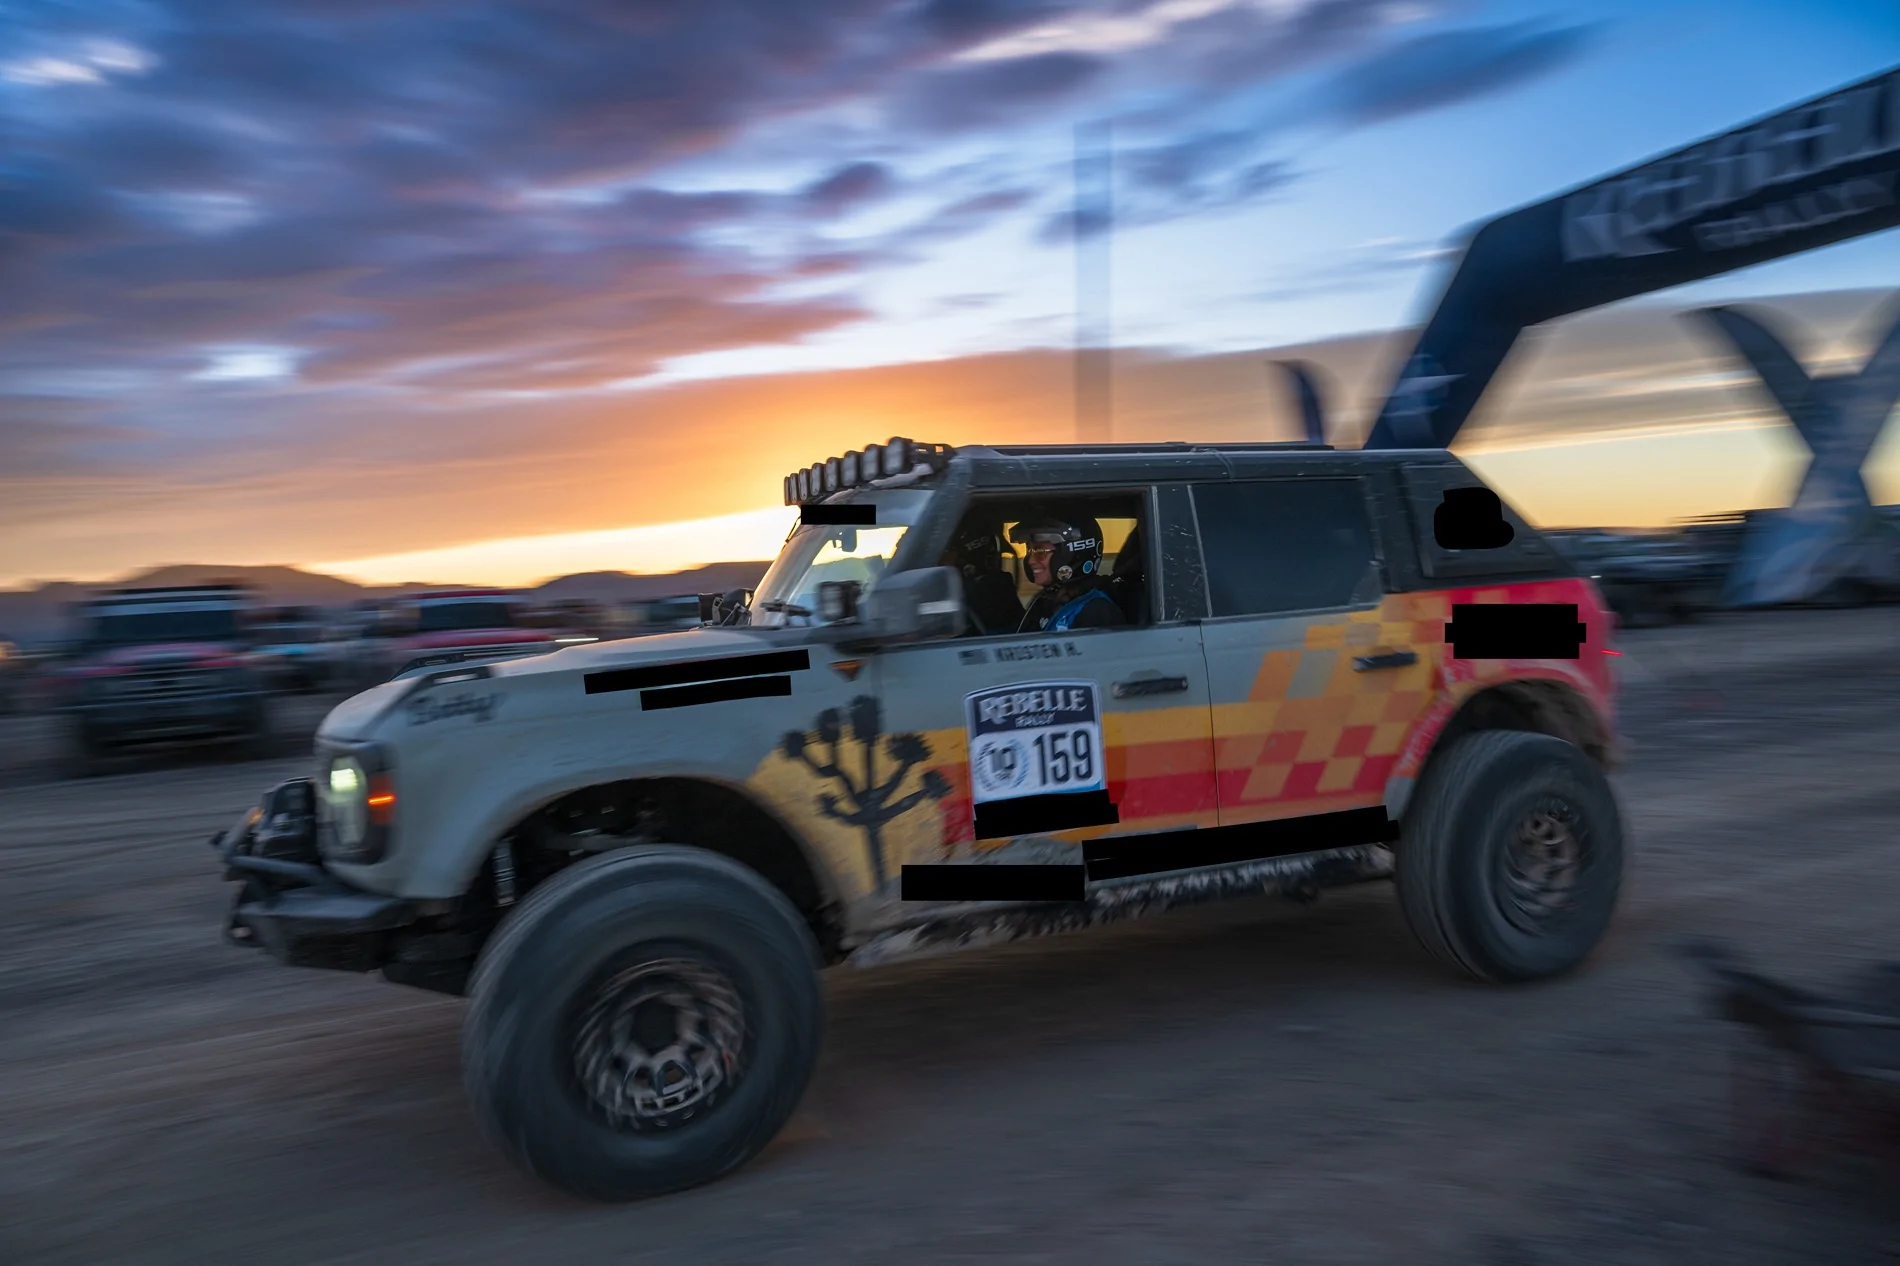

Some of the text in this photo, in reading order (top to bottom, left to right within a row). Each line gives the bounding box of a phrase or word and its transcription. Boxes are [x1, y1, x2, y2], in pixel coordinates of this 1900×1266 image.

[1066, 537, 1096, 552] 159
[979, 689, 1087, 724] REBELLE
[1033, 728, 1093, 786] 159
